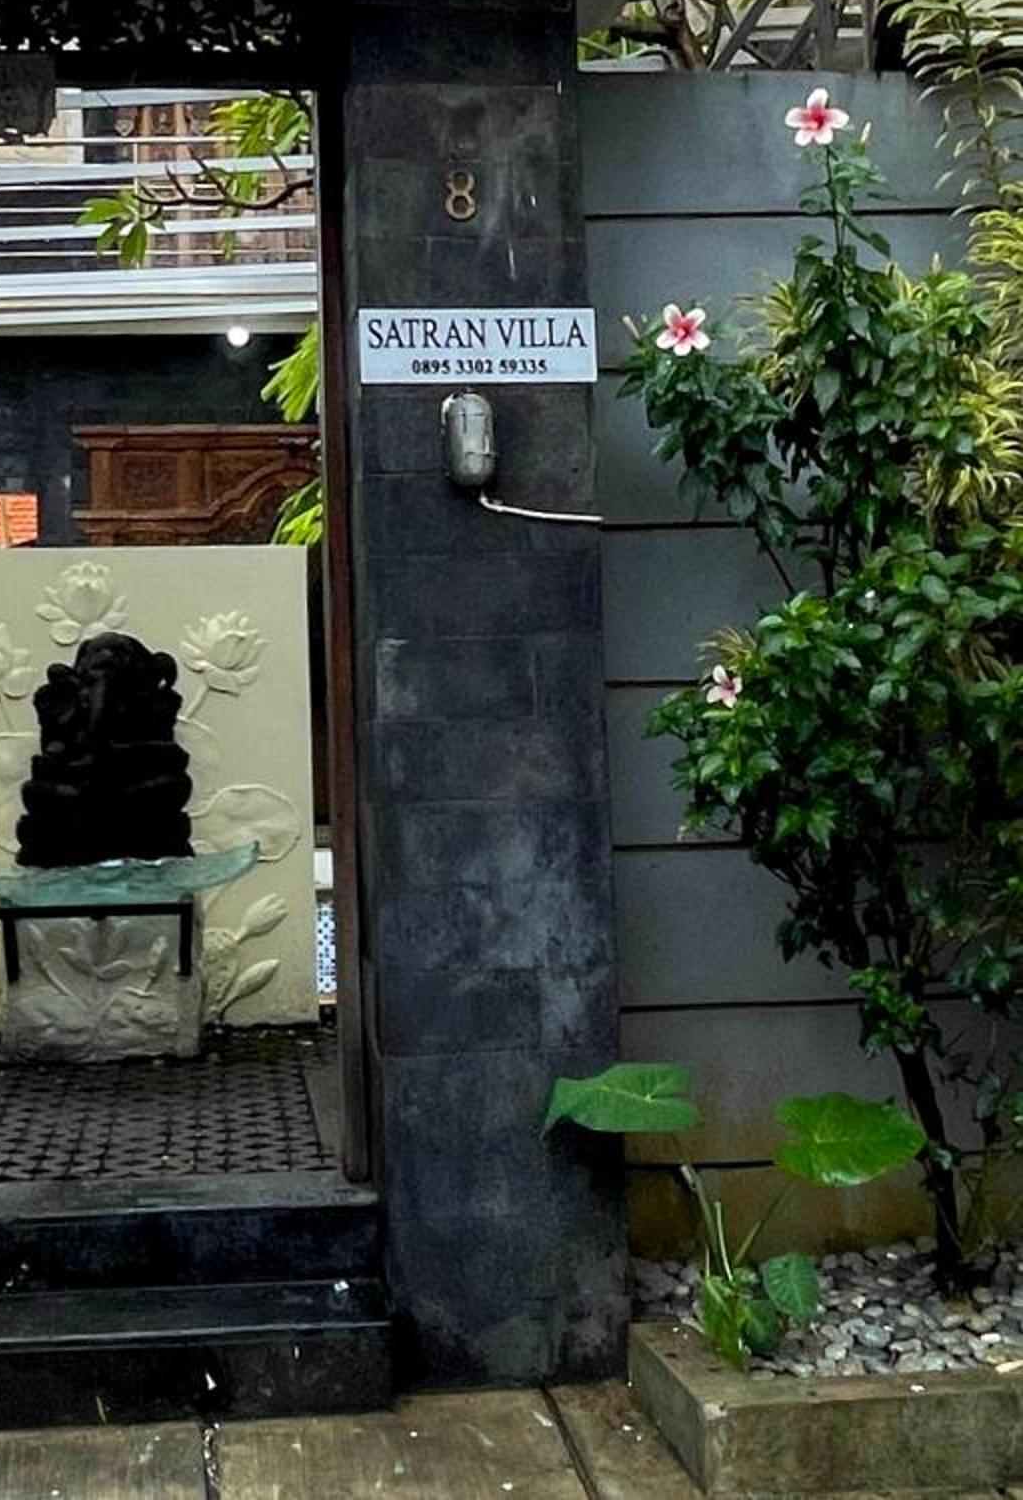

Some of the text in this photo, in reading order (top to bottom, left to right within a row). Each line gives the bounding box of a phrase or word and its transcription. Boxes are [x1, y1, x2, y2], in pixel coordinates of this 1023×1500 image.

[445, 171, 476, 220] 8
[368, 318, 586, 348] SATRAN VILLA
[412, 359, 548, 374] 0895 3302 59335
